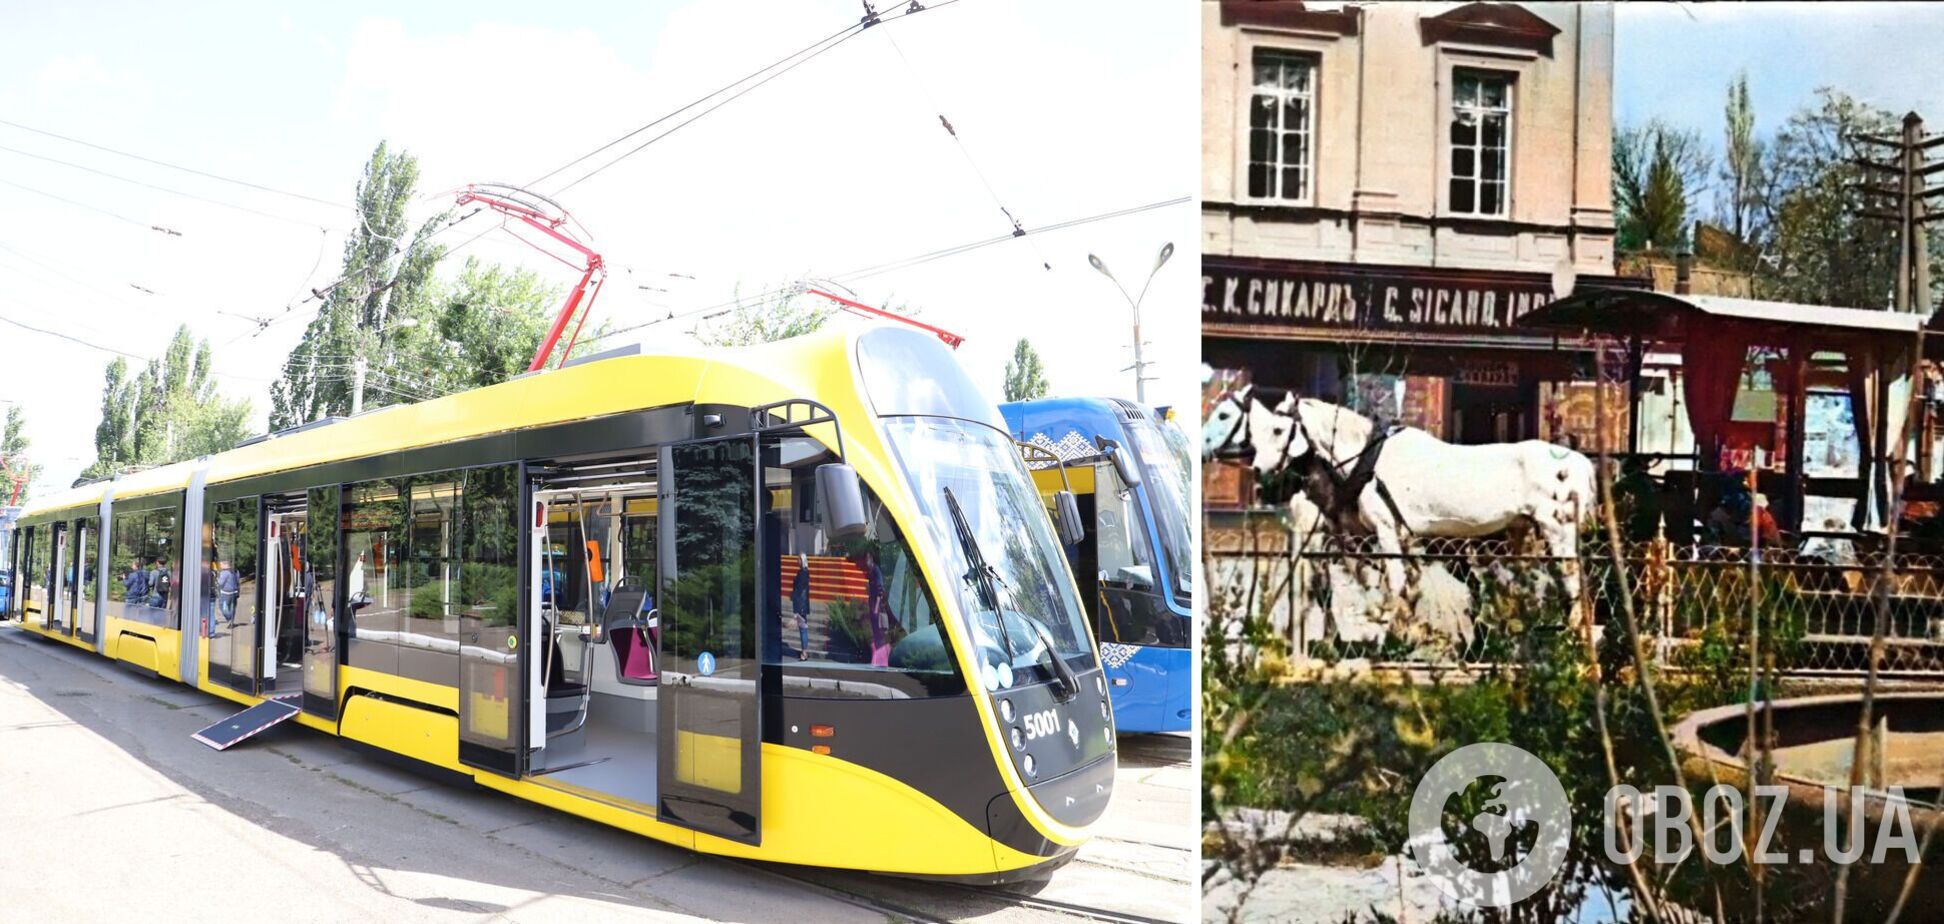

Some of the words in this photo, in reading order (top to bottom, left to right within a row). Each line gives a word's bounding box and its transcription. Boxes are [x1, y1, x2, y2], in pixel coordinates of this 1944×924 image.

[1223, 277, 1242, 315] К.
[1247, 278, 1357, 323] СИКАРДЪ
[1023, 708, 1061, 740] 5001
